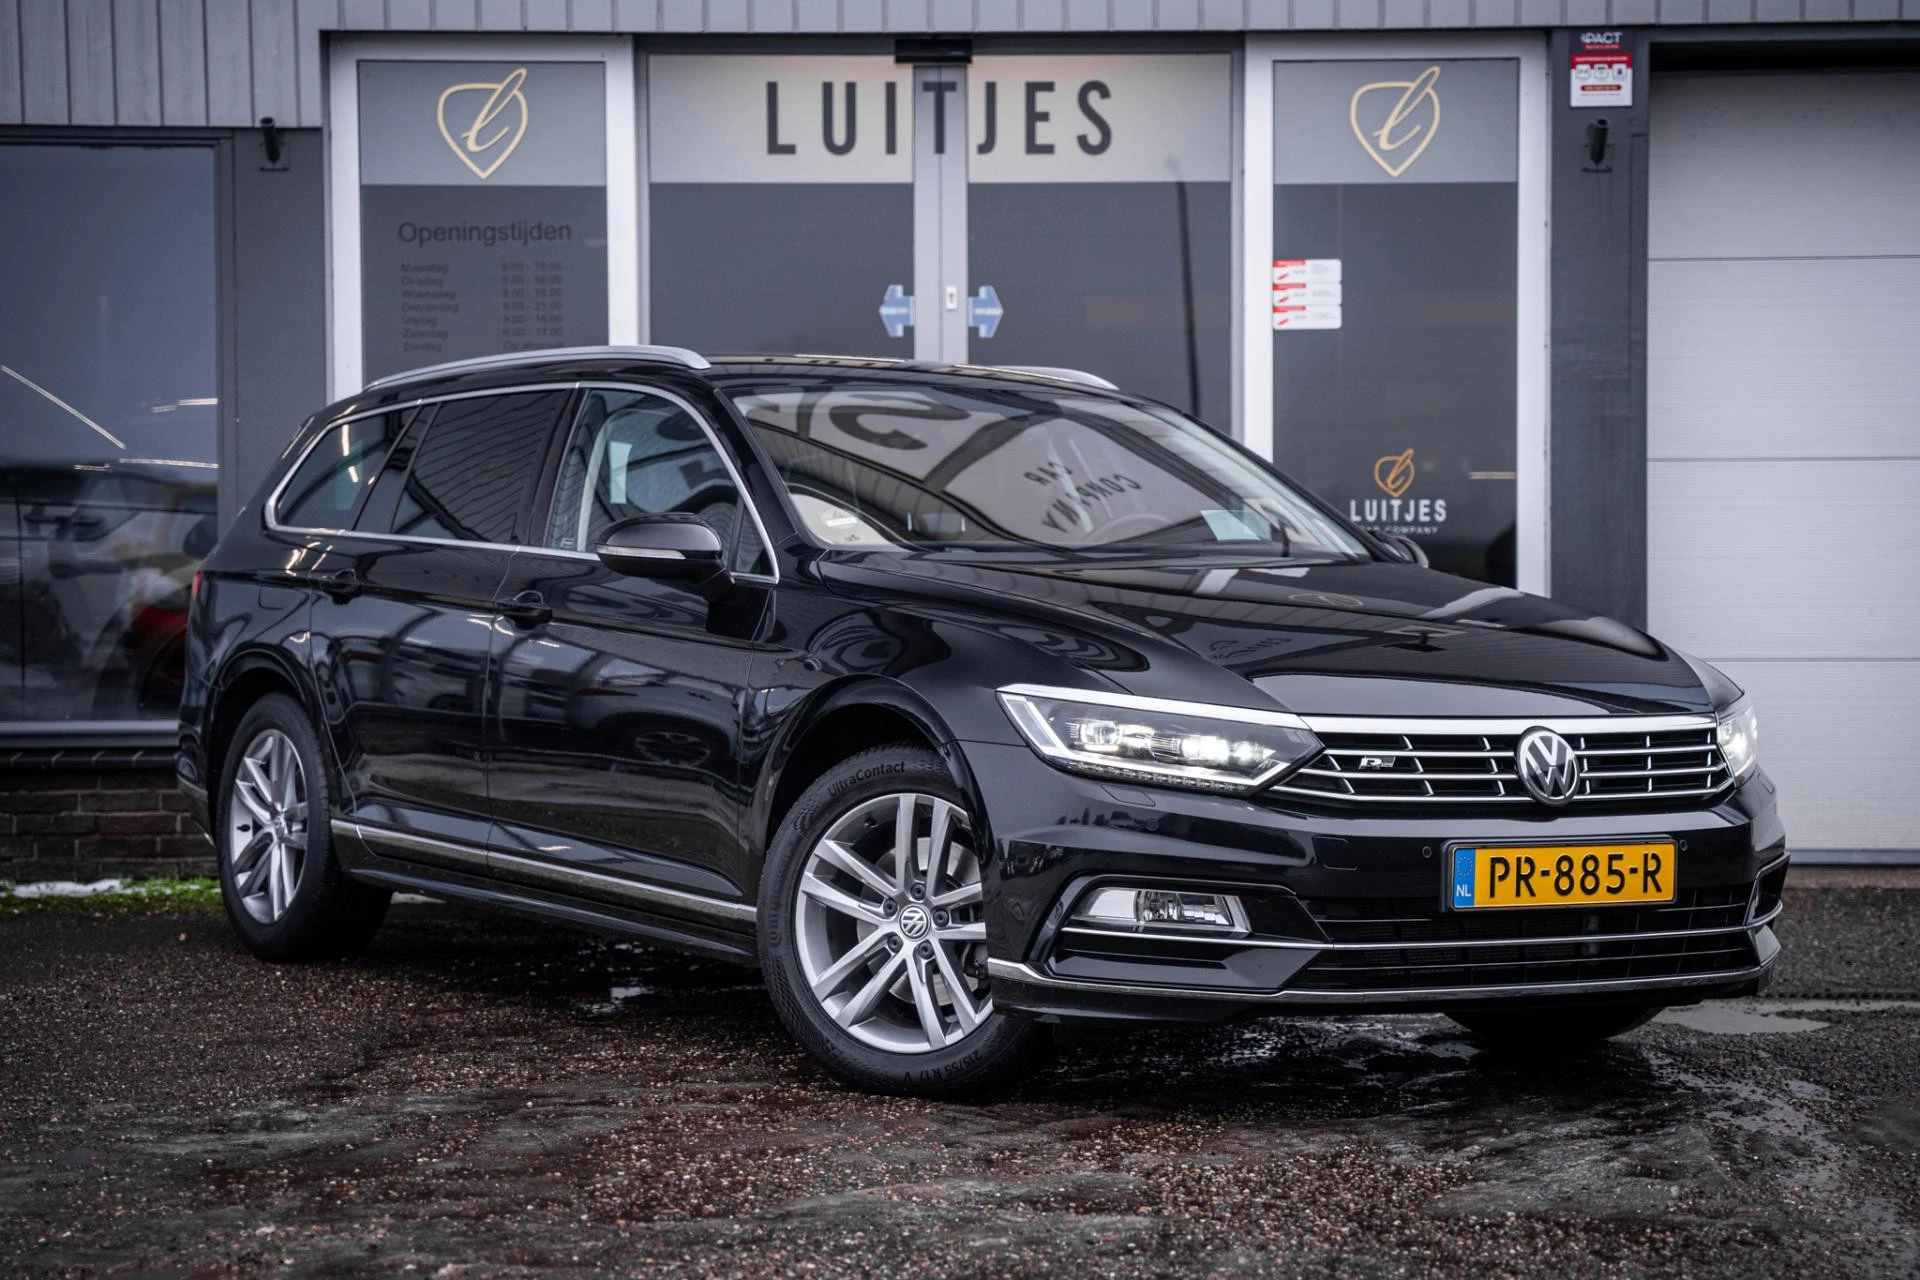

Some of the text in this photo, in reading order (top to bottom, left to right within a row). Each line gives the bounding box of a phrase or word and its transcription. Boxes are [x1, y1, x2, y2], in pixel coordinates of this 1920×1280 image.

[766, 80, 1112, 155] LUITJES
[398, 221, 572, 247] Openingstijden
[1350, 499, 1447, 522] LUITJES
[827, 761, 906, 797] UltraContact
[1456, 884, 1471, 897] NL
[1489, 852, 1663, 898] PR-885-R
